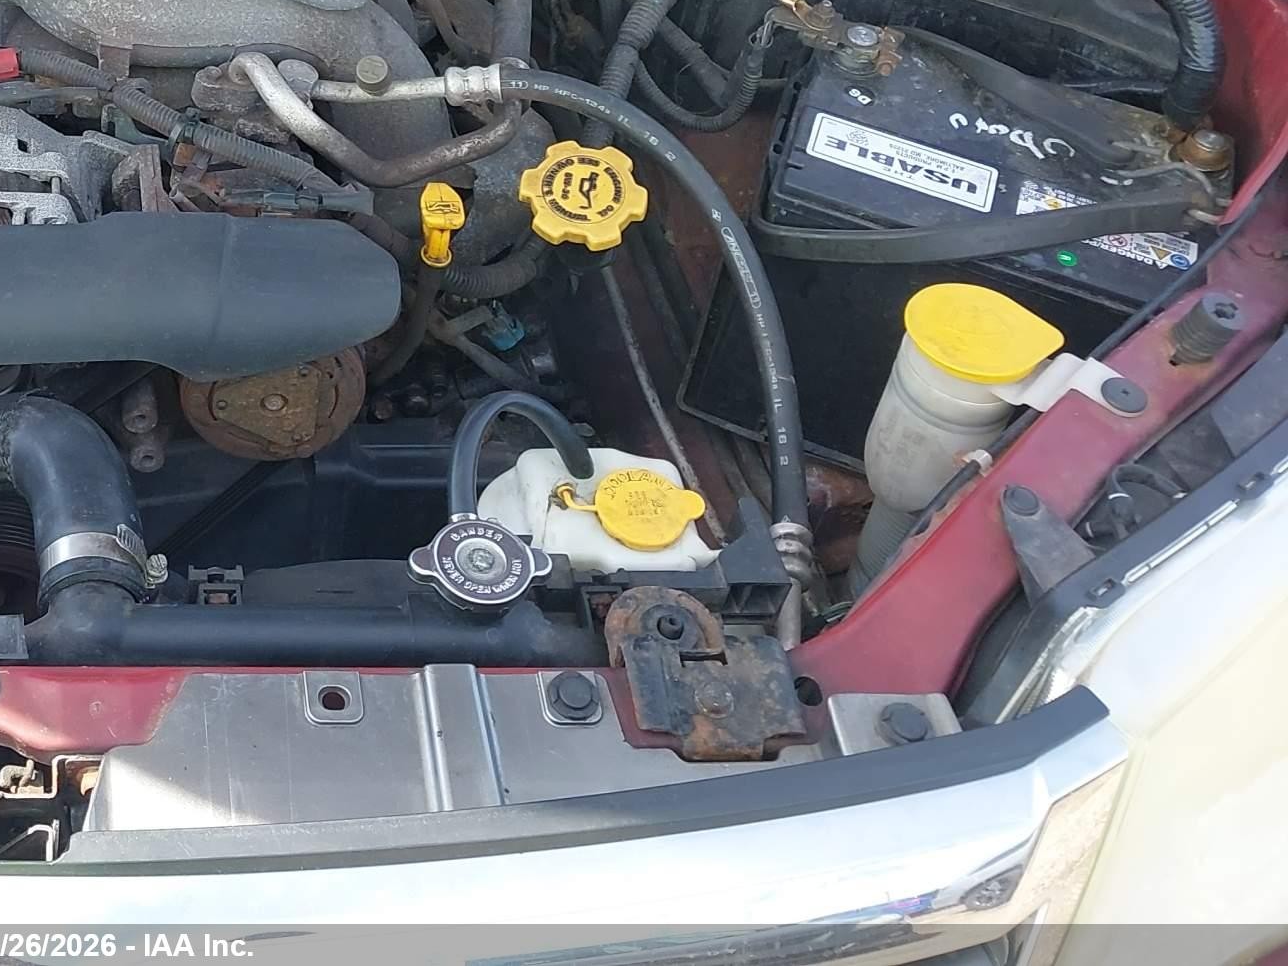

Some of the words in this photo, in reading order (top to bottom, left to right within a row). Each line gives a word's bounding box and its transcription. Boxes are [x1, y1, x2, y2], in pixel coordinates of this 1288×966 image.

[824, 135, 978, 194] USABLE
[450, 527, 503, 542] DANGER
[442, 556, 465, 584] NEVER
[464, 581, 491, 594] OPEN
[492, 576, 518, 593] WHEN
